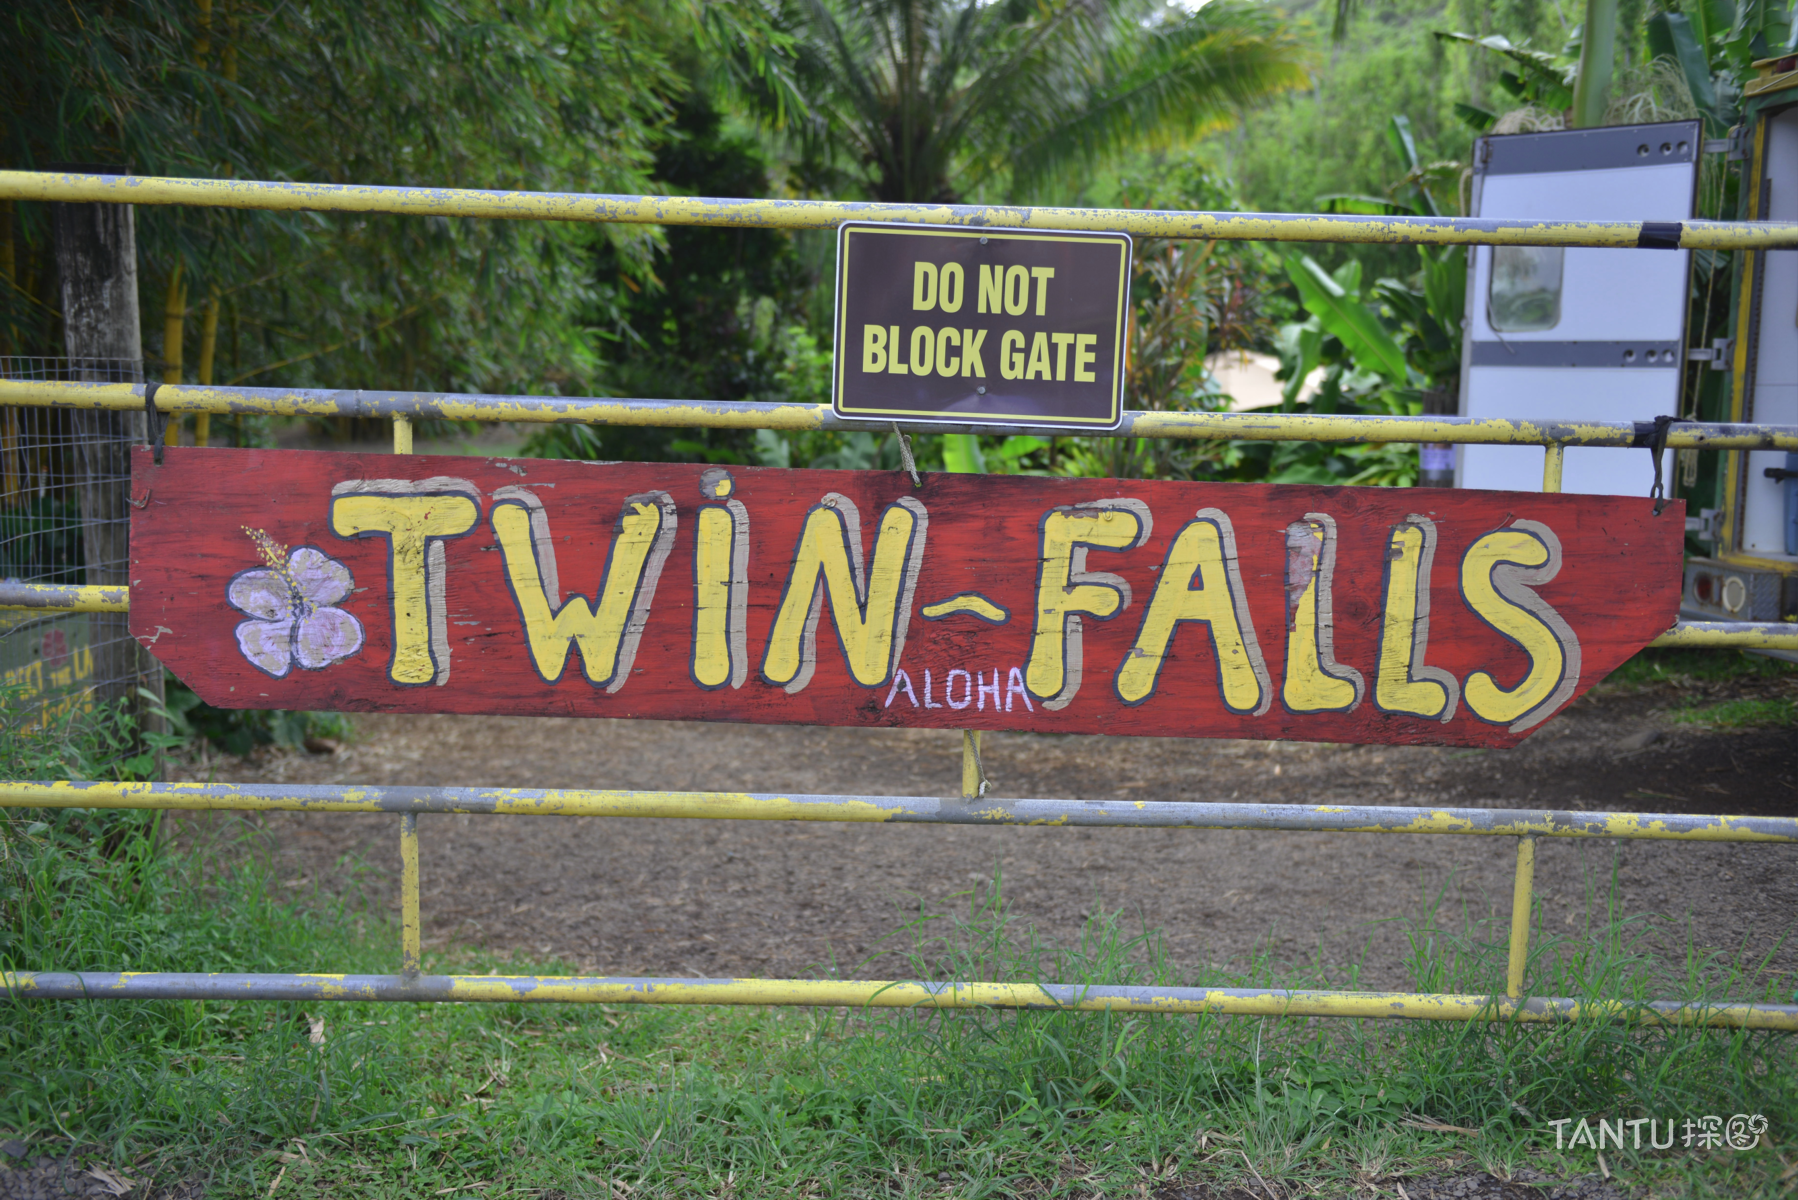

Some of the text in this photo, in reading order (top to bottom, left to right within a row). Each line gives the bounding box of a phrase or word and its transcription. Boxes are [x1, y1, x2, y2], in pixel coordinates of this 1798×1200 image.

[912, 261, 1056, 317] DO NOT
[861, 323, 1098, 383] BLOCK GATE
[885, 667, 1035, 713] ALOHA
